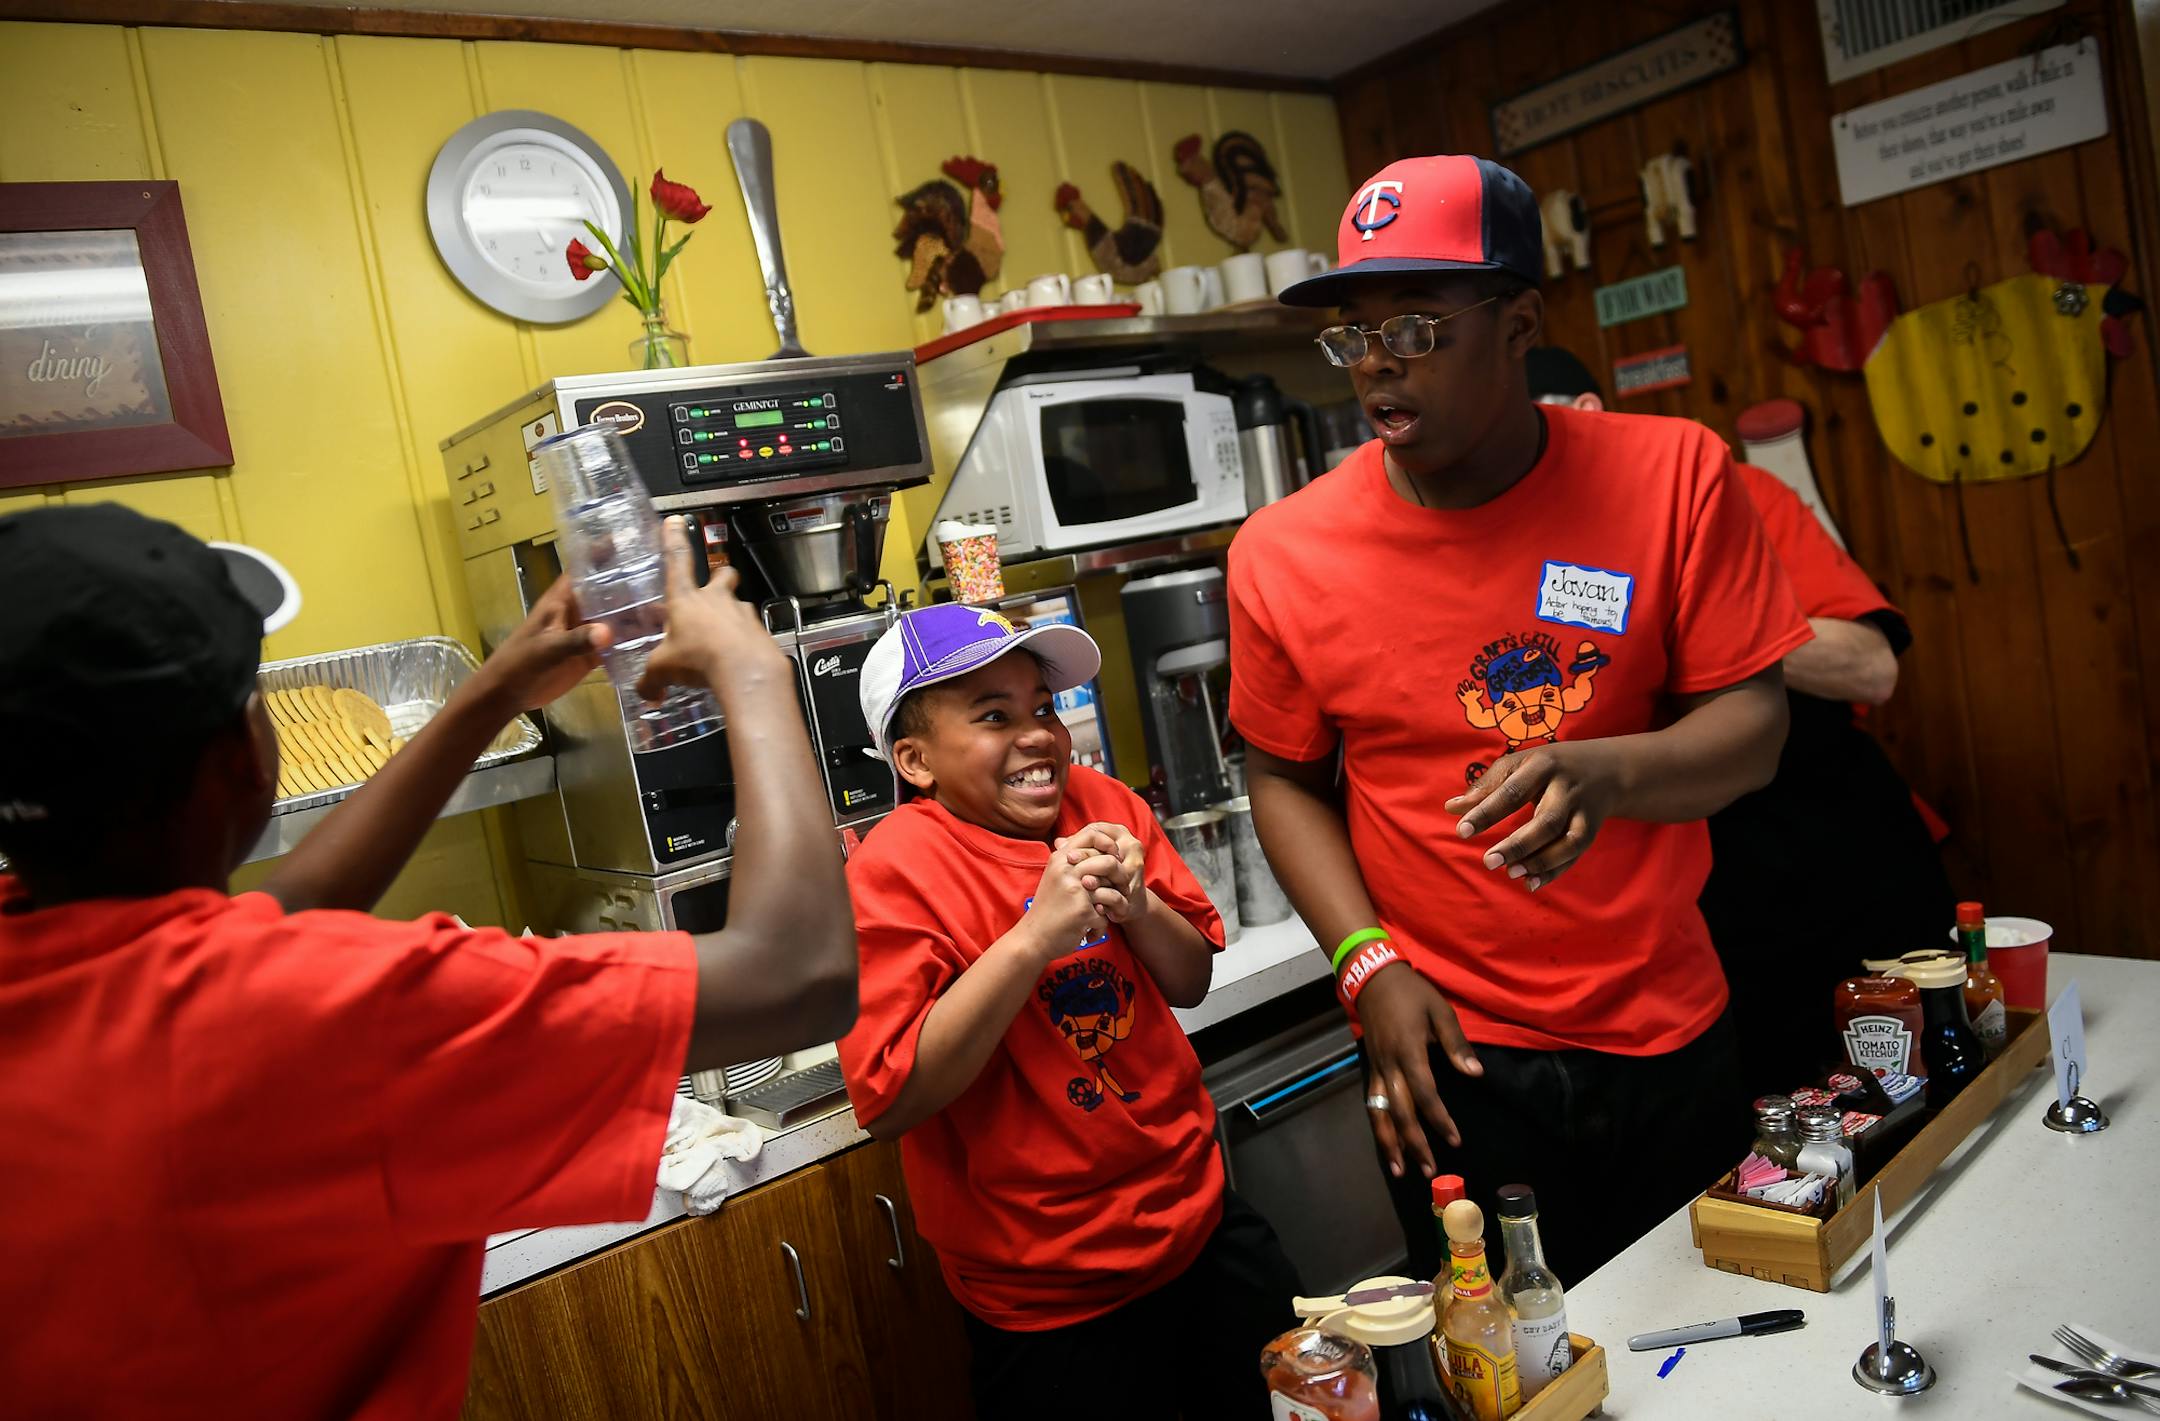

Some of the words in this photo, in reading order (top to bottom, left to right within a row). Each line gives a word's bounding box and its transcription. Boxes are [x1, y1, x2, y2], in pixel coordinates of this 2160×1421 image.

[1524, 93, 1571, 130] HOT
[1580, 46, 1698, 104] BISCUITS
[1935, 89, 1969, 116] another
[2005, 69, 2029, 94] walk
[1928, 125, 1947, 146] that
[1948, 122, 1968, 140] way
[2006, 98, 2029, 124] mile
[2029, 96, 2056, 117] away
[1972, 140, 1996, 160] their
[519, 158, 531, 172] 12
[1551, 569, 1619, 603] Javan
[1860, 1024, 1893, 1035] HEINZ
[1856, 1040, 1900, 1051] TOMATO
[1859, 1049, 1899, 1058] KETCHUP
